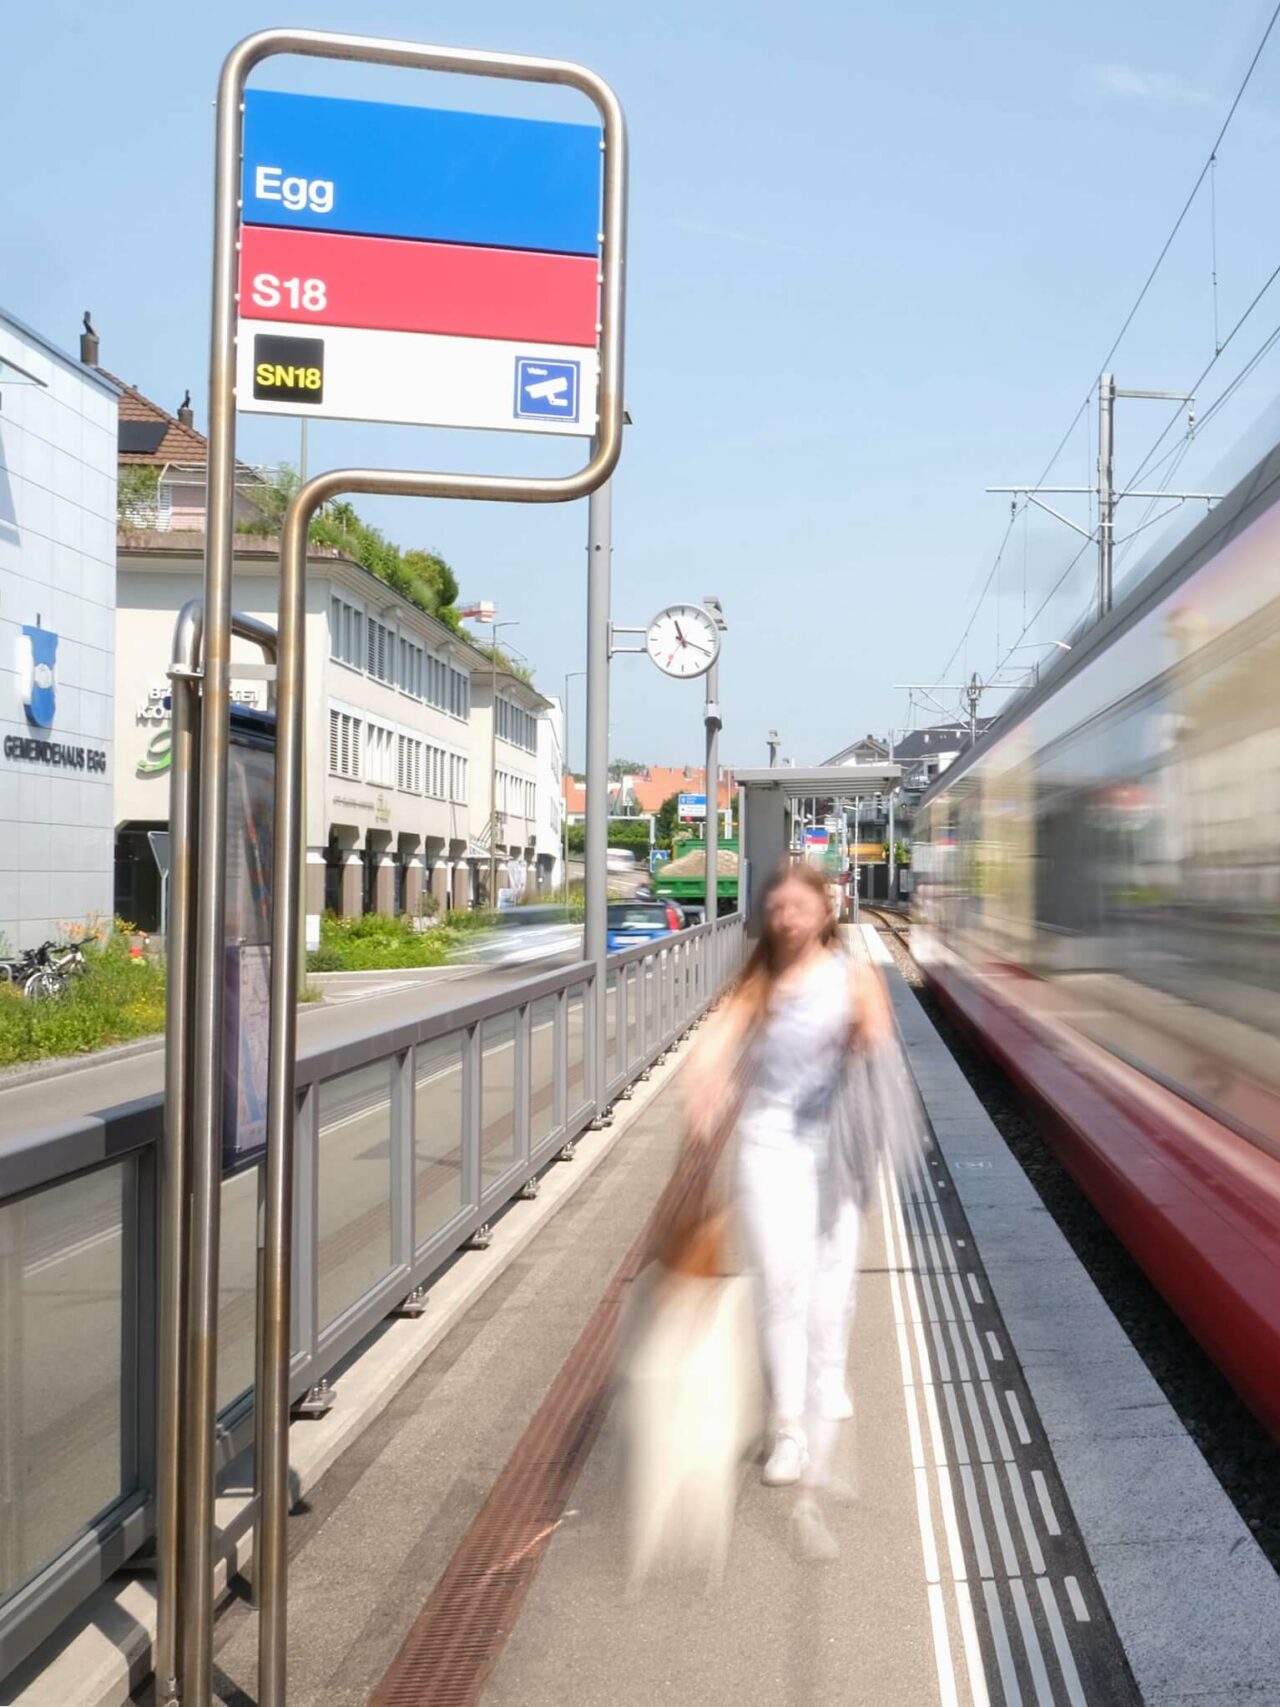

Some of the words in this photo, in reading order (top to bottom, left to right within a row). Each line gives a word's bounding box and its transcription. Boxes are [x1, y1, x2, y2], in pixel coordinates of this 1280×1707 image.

[255, 165, 334, 213] Egg
[252, 273, 327, 311] S18
[256, 363, 321, 389] SN18
[4, 734, 84, 770] GEMEINDEHAUS
[86, 748, 106, 773] EGG
